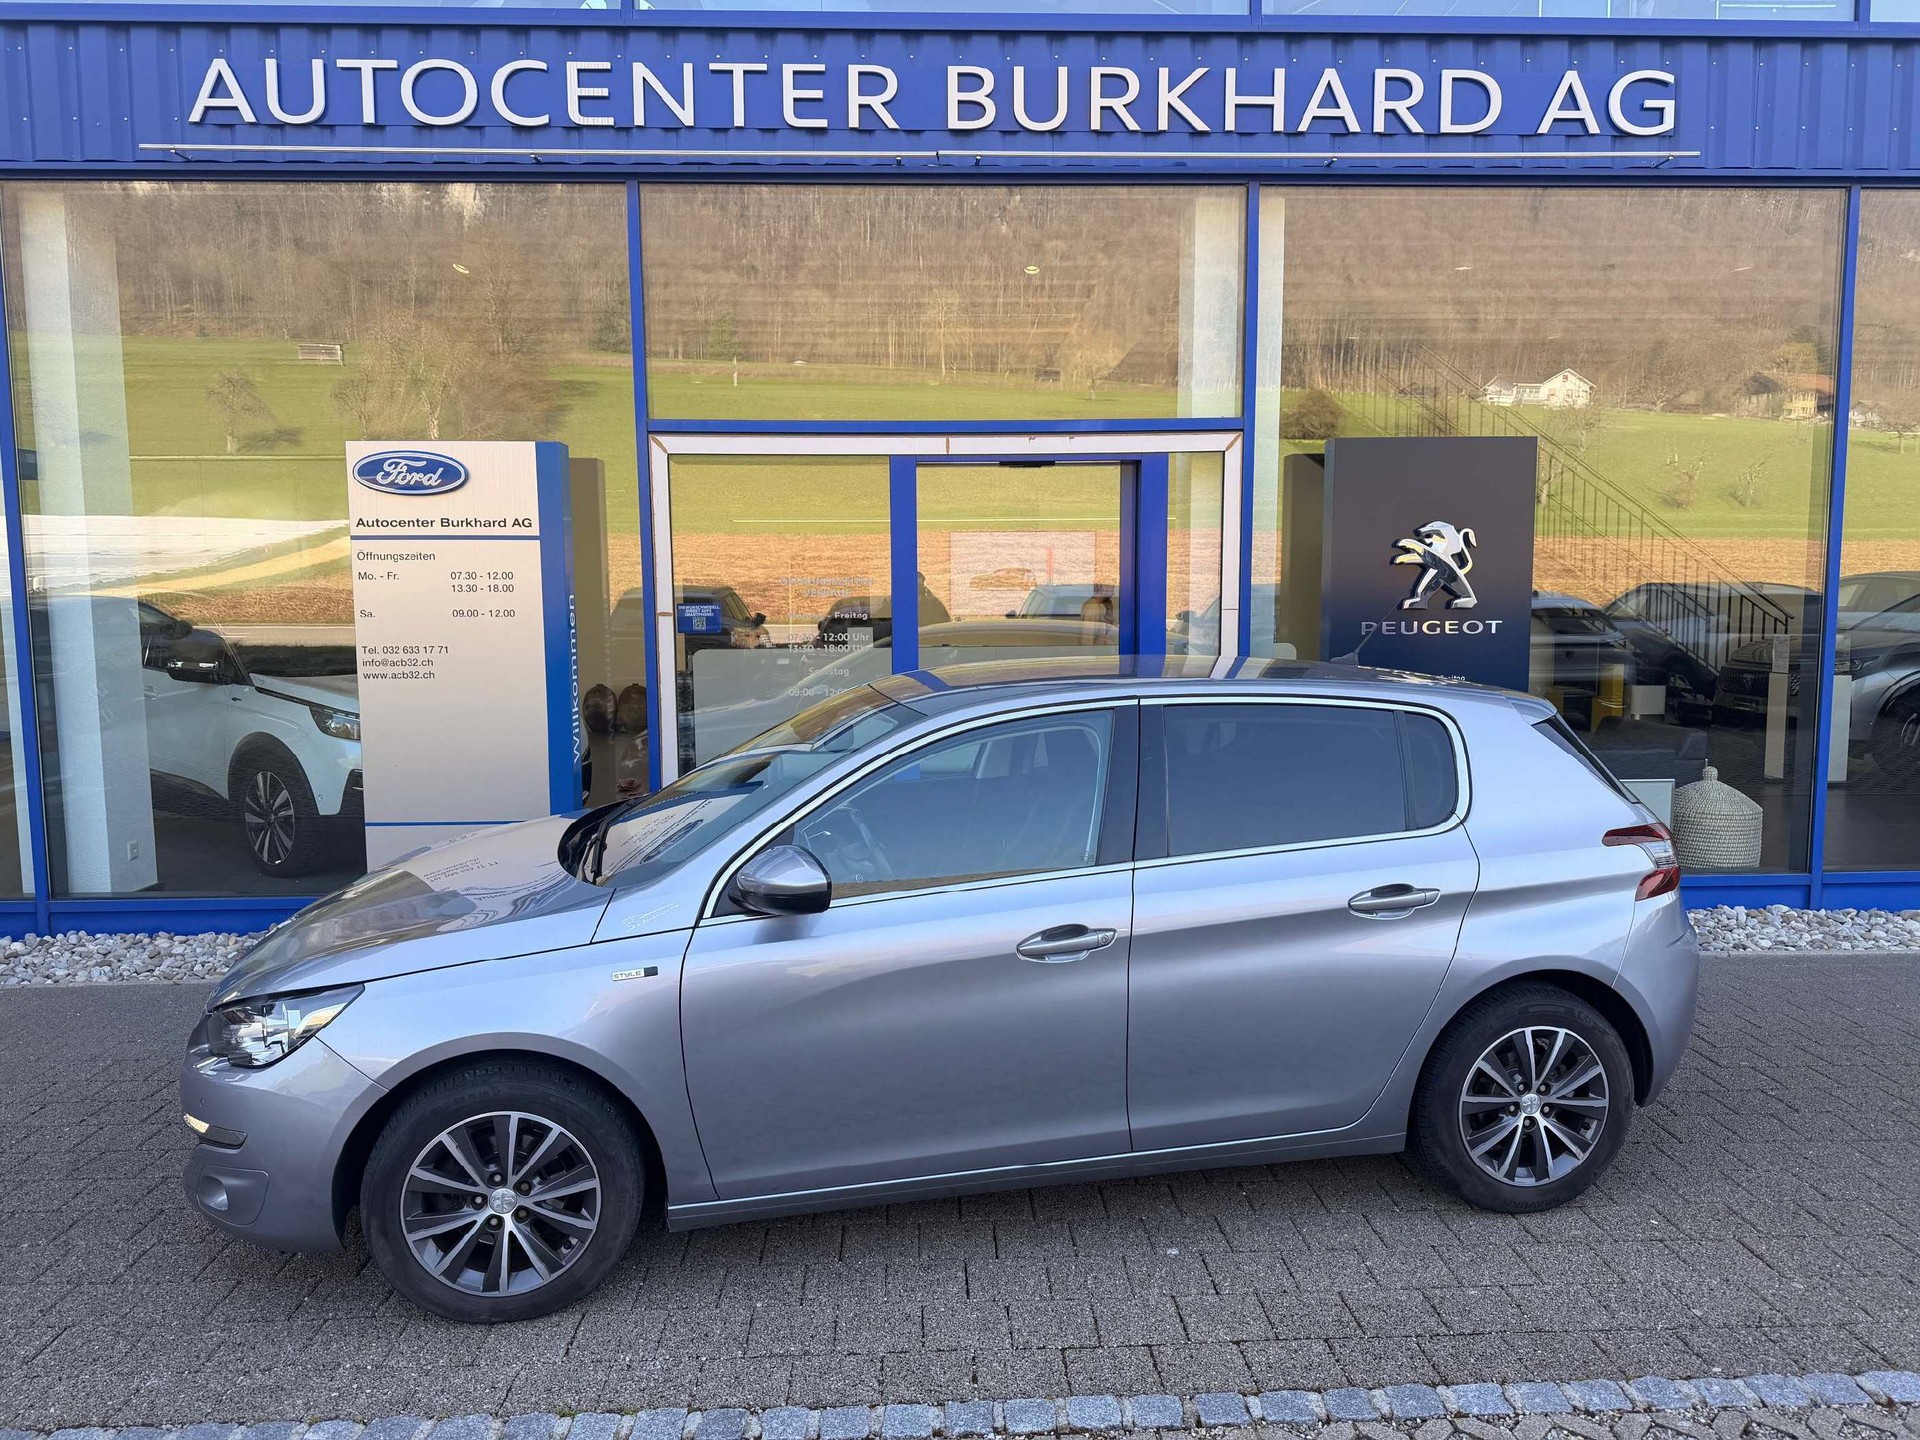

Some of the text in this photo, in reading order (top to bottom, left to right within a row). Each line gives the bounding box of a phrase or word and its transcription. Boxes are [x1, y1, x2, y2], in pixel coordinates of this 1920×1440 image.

[187, 57, 1676, 135] AUTOCENTER BURKHARD AG
[376, 458, 444, 486] Ford
[355, 517, 533, 528] Autocenter Burkhard AG
[356, 549, 436, 563] Öffnungszeiten
[357, 571, 377, 581] Mo.
[387, 571, 400, 580] Fr.
[450, 571, 477, 580] 07.30
[487, 571, 514, 580] 12.00
[451, 584, 478, 593] 13.30
[488, 584, 515, 593] 18.00
[359, 609, 376, 618] Sa.
[452, 609, 479, 618] 09.00
[489, 609, 516, 618] 12.00
[834, 611, 868, 620] Freitag
[1360, 620, 1503, 635] PEUGEOT
[823, 633, 850, 641] 12:00
[852, 633, 870, 641] Uhr
[361, 645, 449, 655] Tel. 032 633 17 71
[788, 644, 815, 653] 13:30
[823, 644, 850, 653] 18:00
[362, 658, 434, 667] info@acb32.ch
[363, 671, 436, 680] www.acb32.ch
[568, 594, 582, 763] Willkommen
[788, 688, 815, 697] 09:00
